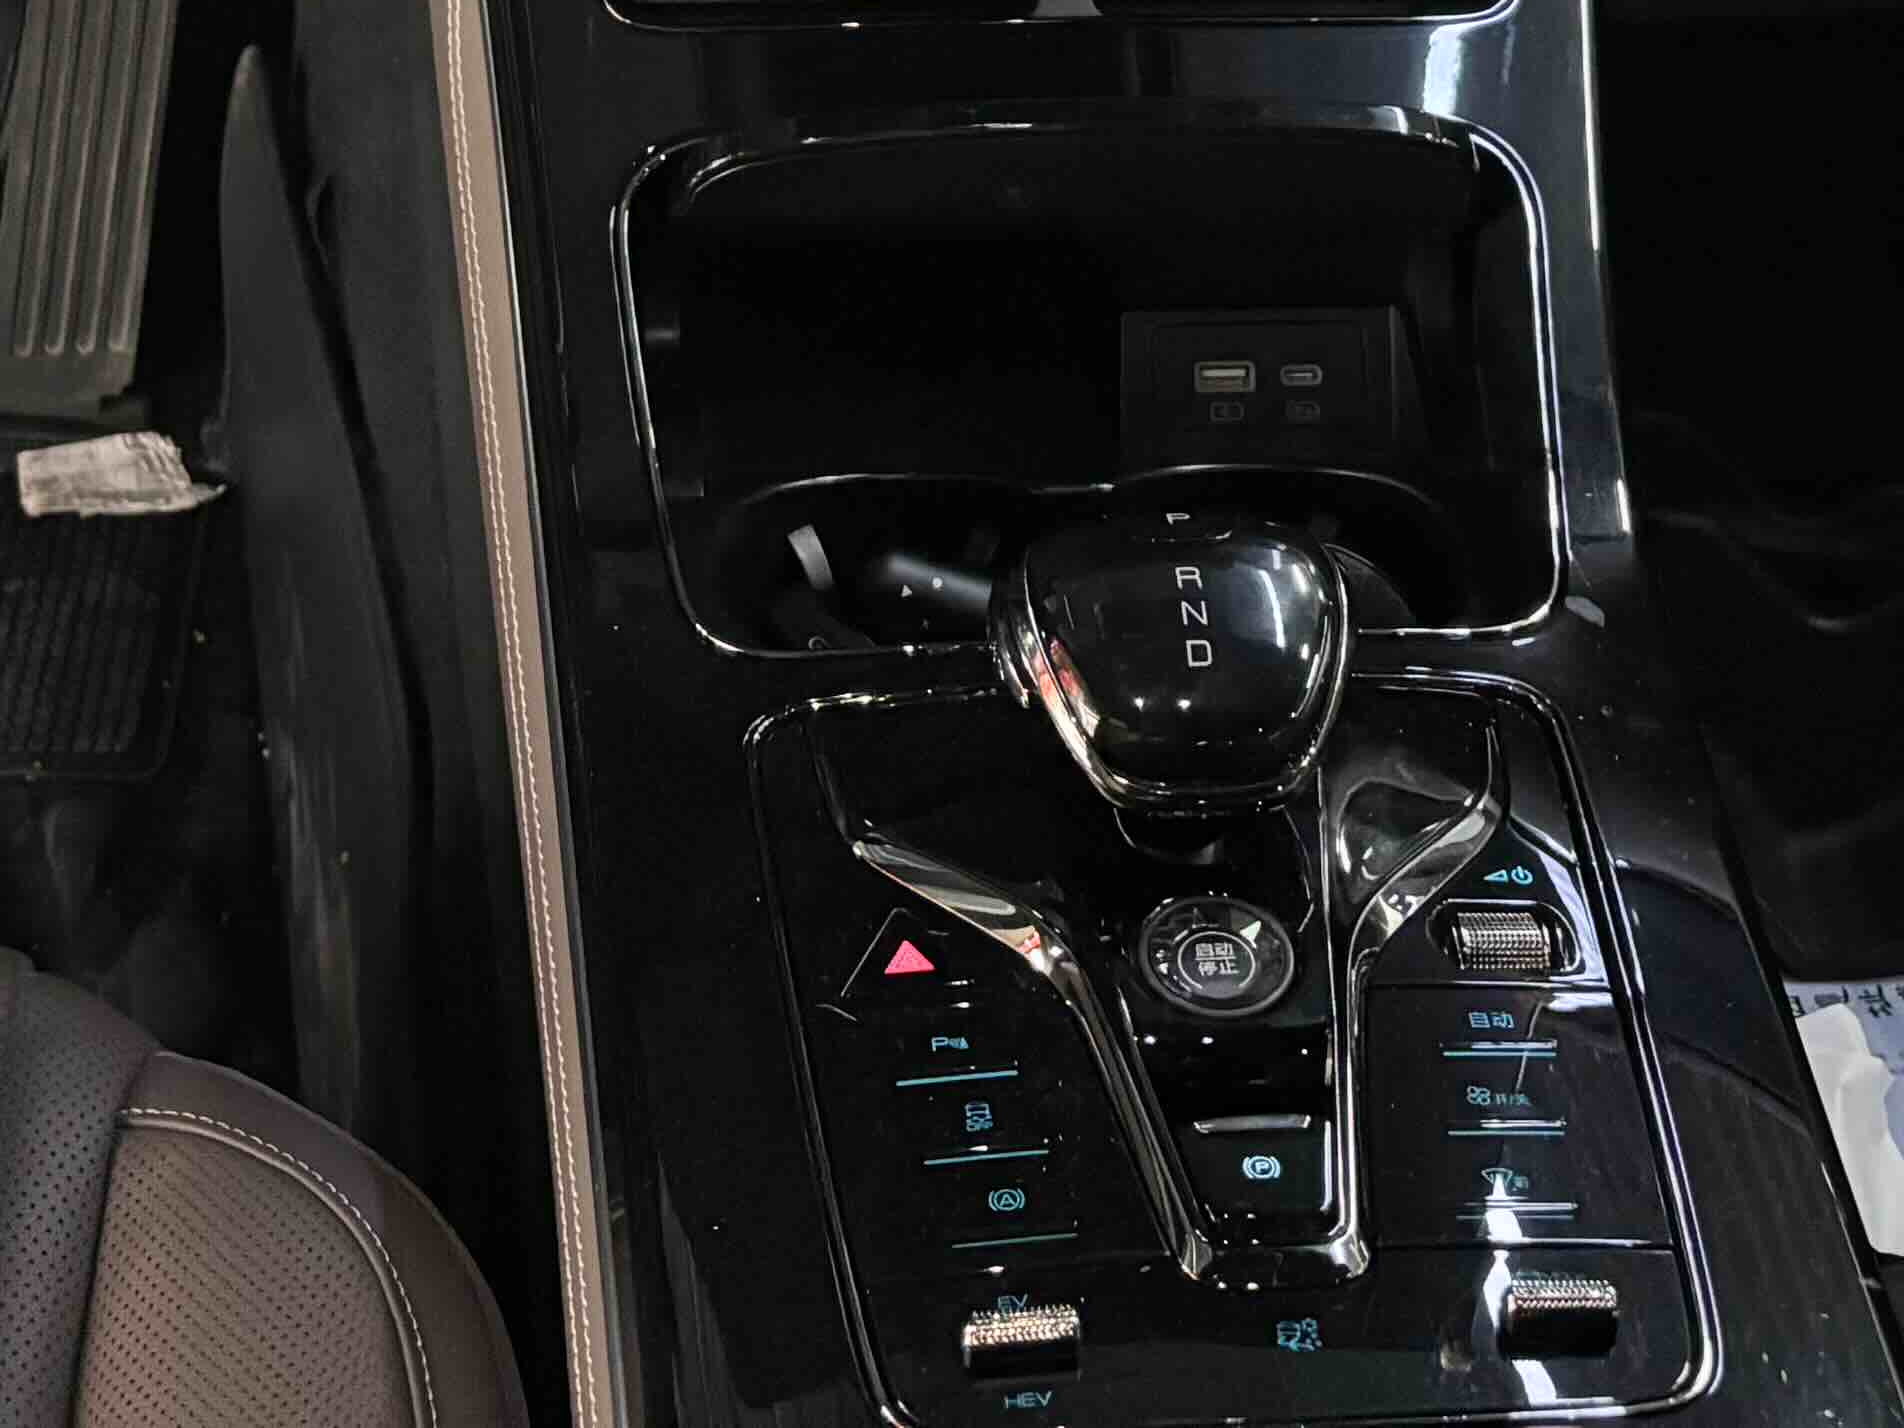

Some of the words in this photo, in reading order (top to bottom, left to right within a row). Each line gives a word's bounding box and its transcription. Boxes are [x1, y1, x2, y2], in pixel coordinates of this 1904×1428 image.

[1174, 566, 1203, 591] R
[1180, 600, 1209, 627] N
[1185, 638, 1213, 667] D
[1198, 958, 1241, 977] 停止
[1468, 1011, 1516, 1029] 自动
[1003, 1391, 1053, 1409] HEV
